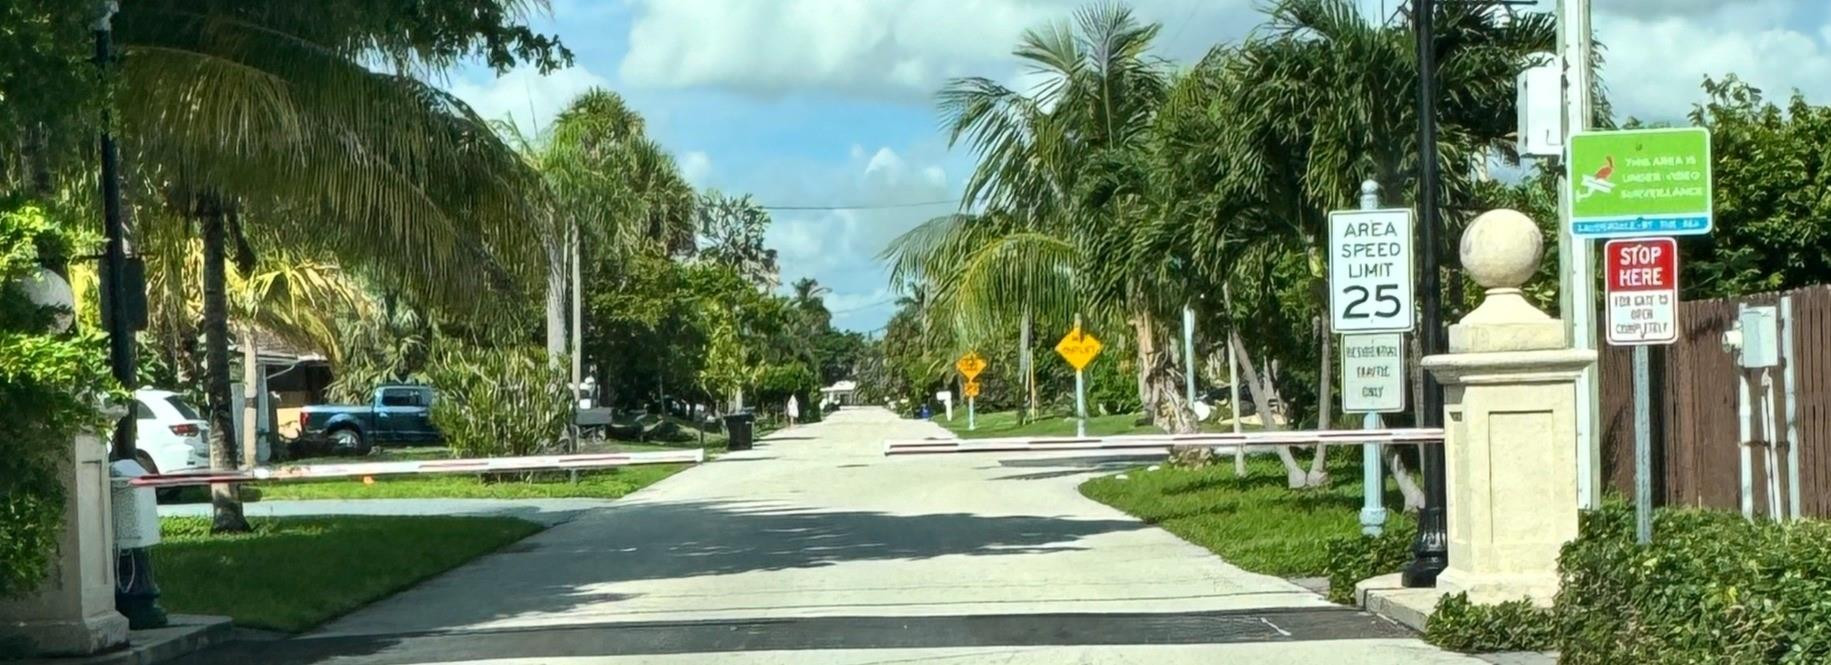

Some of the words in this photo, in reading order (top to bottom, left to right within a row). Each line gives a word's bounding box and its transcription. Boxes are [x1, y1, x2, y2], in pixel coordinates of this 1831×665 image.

[1652, 156, 1683, 166] AREA
[1622, 173, 1661, 183] UNDER
[1344, 221, 1398, 238] AREA
[1341, 242, 1401, 258] SPEED
[1620, 246, 1662, 265] STOP
[1348, 262, 1394, 279] LIMIT
[1619, 267, 1663, 286] HERE
[1342, 283, 1401, 319] 25
[1362, 386, 1384, 398] ONLY
